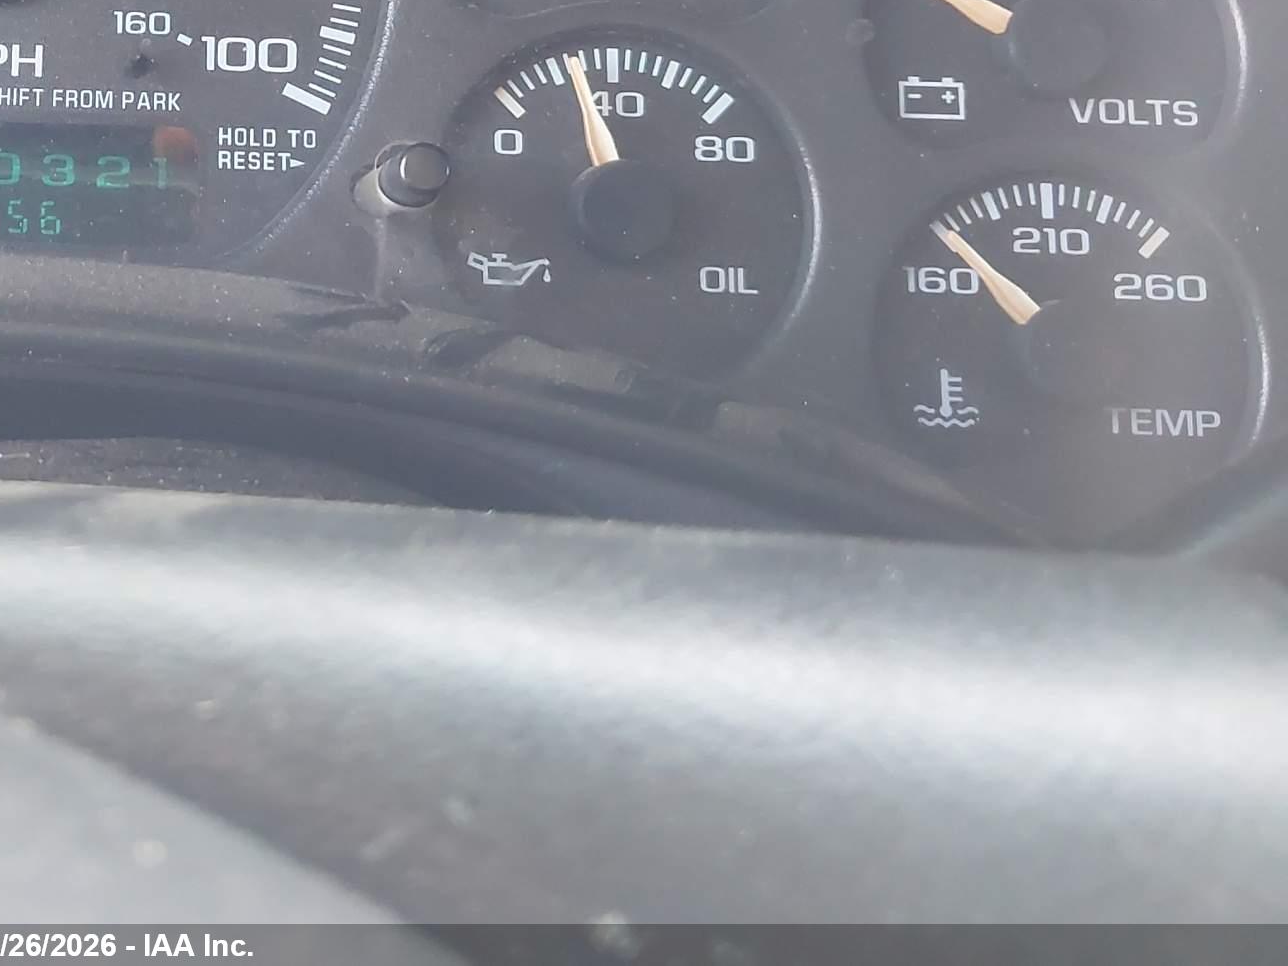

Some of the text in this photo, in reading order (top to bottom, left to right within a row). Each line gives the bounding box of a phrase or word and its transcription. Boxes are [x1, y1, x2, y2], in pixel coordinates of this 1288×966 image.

[113, 11, 171, 36] 160
[202, 36, 298, 73] 100
[52, 89, 113, 109] FROM
[122, 91, 182, 111] PARK
[1069, 98, 1199, 127] VOLTS
[218, 127, 316, 149] HOLD TO
[494, 130, 523, 156] 0
[694, 136, 755, 163] 80
[218, 150, 291, 171] RESET
[1013, 228, 1090, 255] 210
[700, 267, 758, 295] OIL
[902, 266, 979, 294] 160
[1114, 273, 1207, 302] 260
[1111, 407, 1222, 437] TEMP
